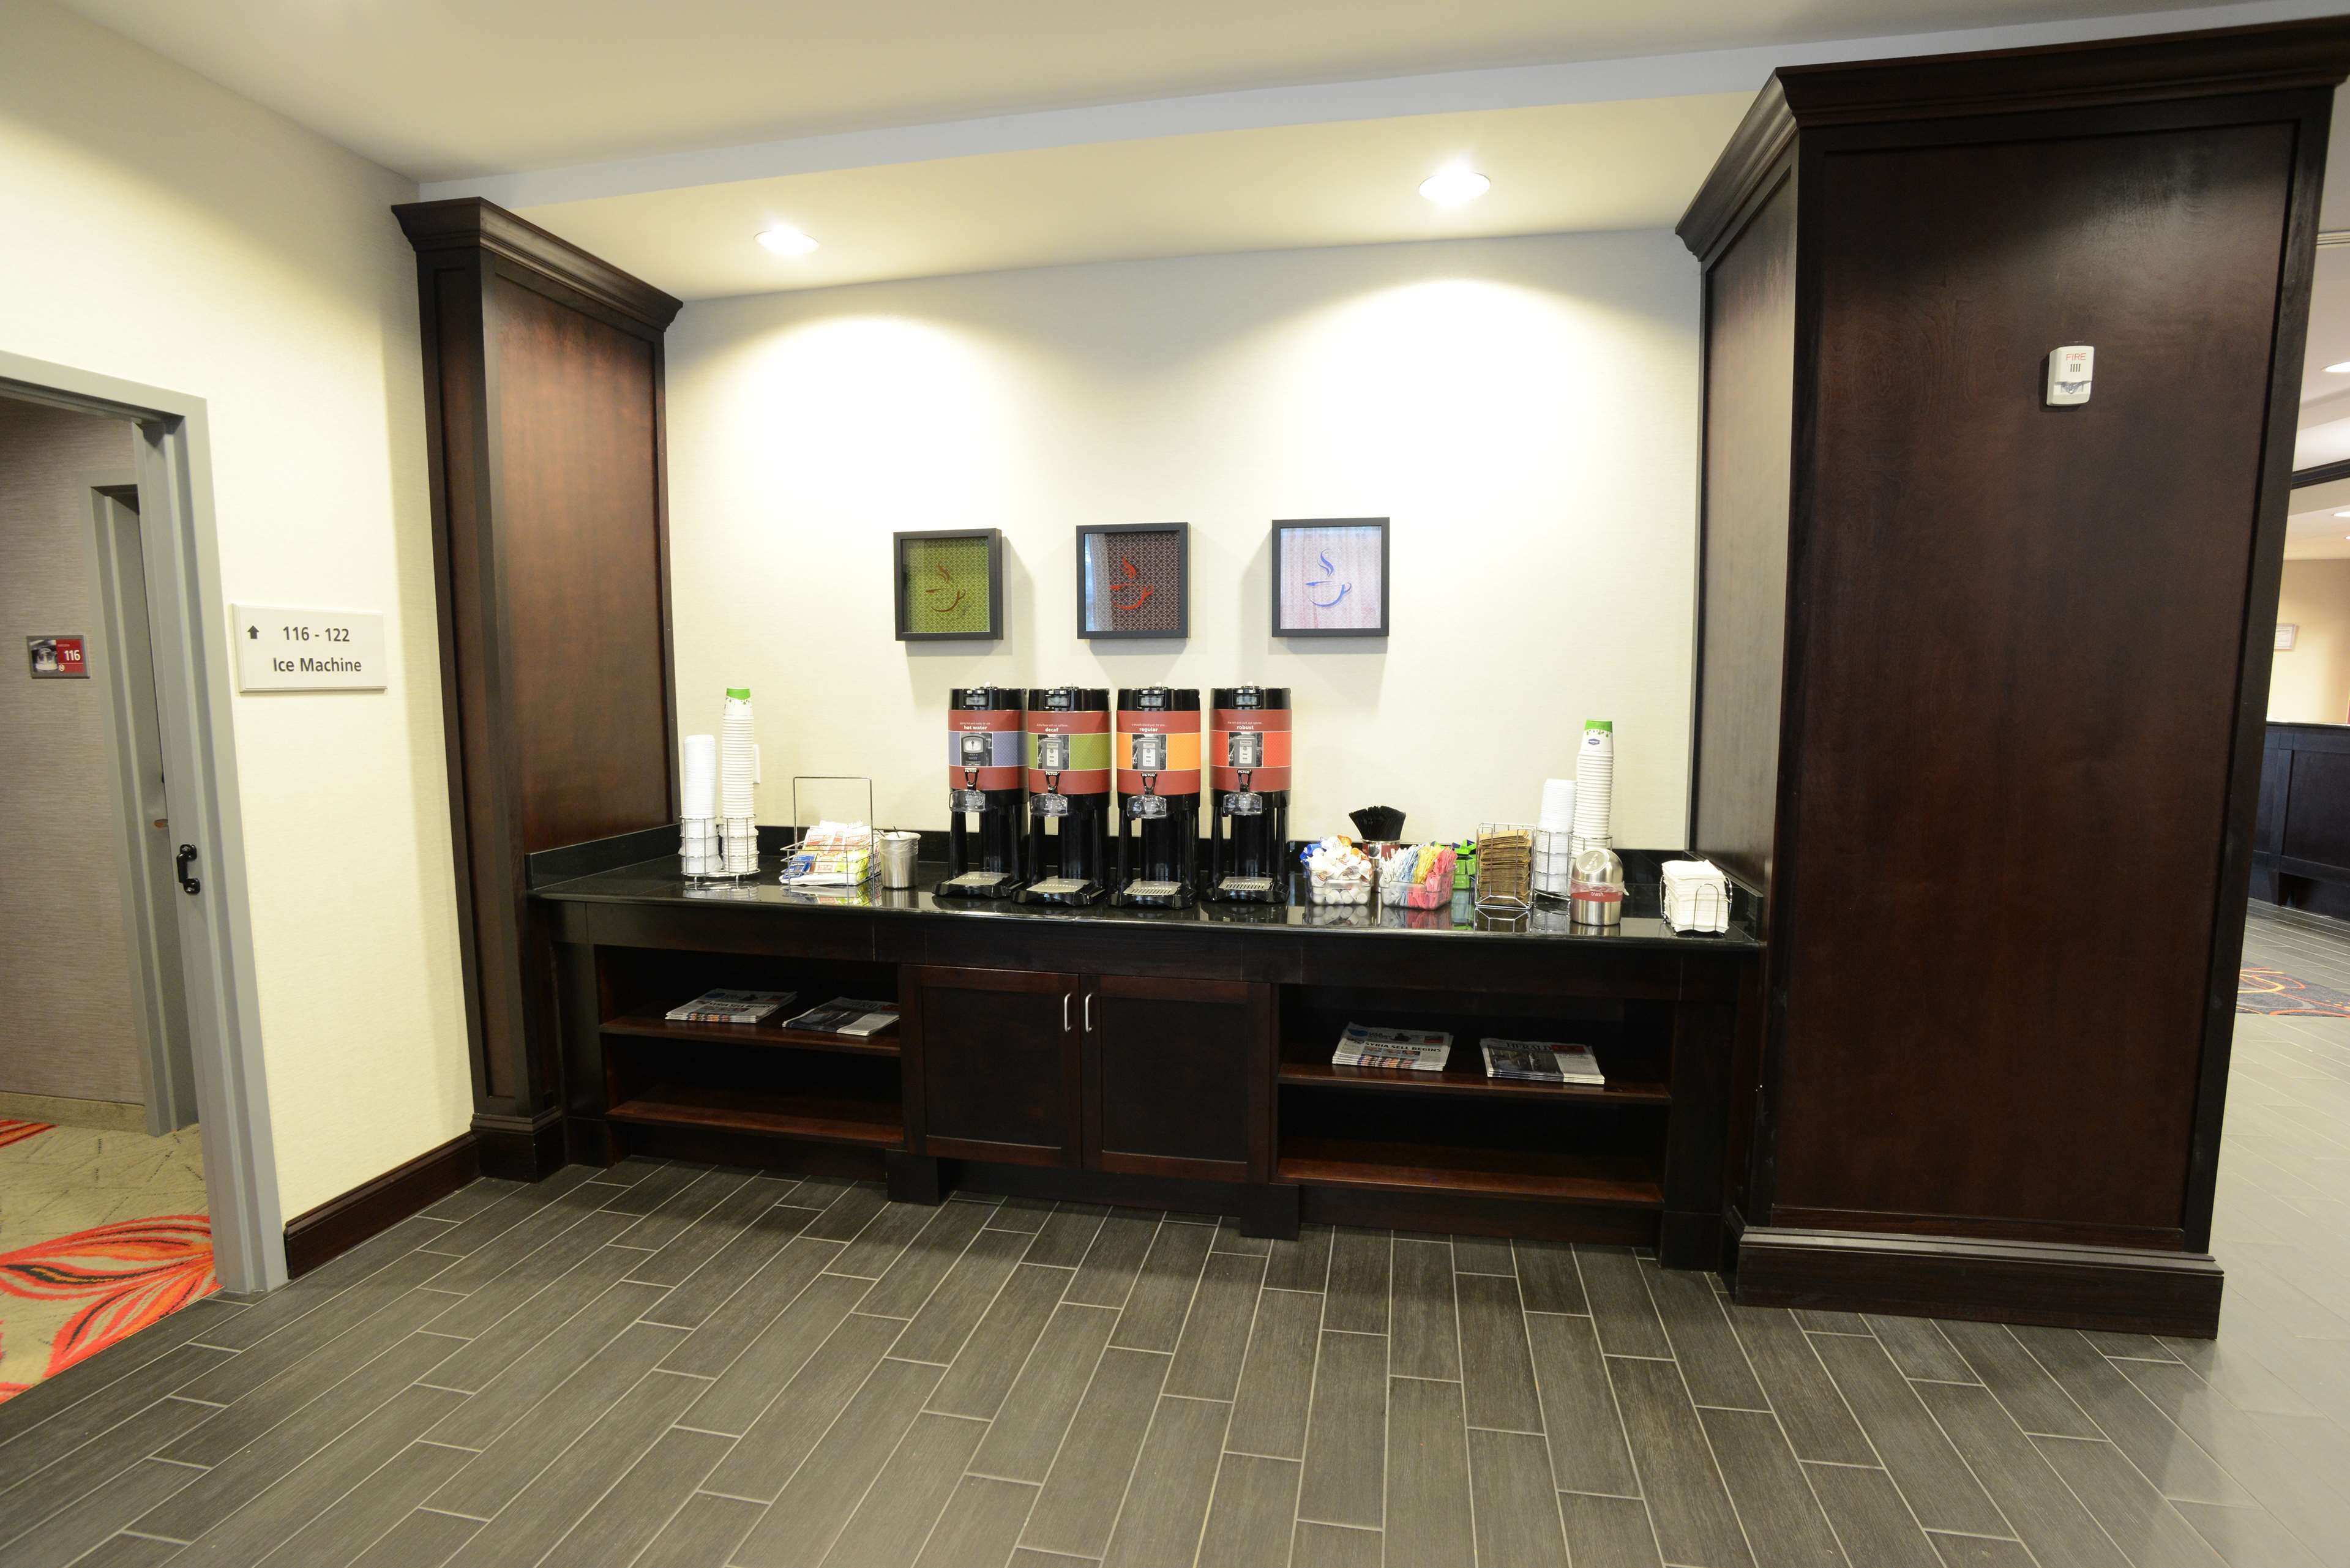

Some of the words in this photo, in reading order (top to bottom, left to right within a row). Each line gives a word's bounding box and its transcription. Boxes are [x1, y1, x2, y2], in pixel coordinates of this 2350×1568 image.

[283, 626, 310, 641] 116
[324, 628, 350, 642] 122
[64, 650, 81, 661] 116
[273, 657, 294, 672] Ice
[300, 657, 362, 672] Machine
